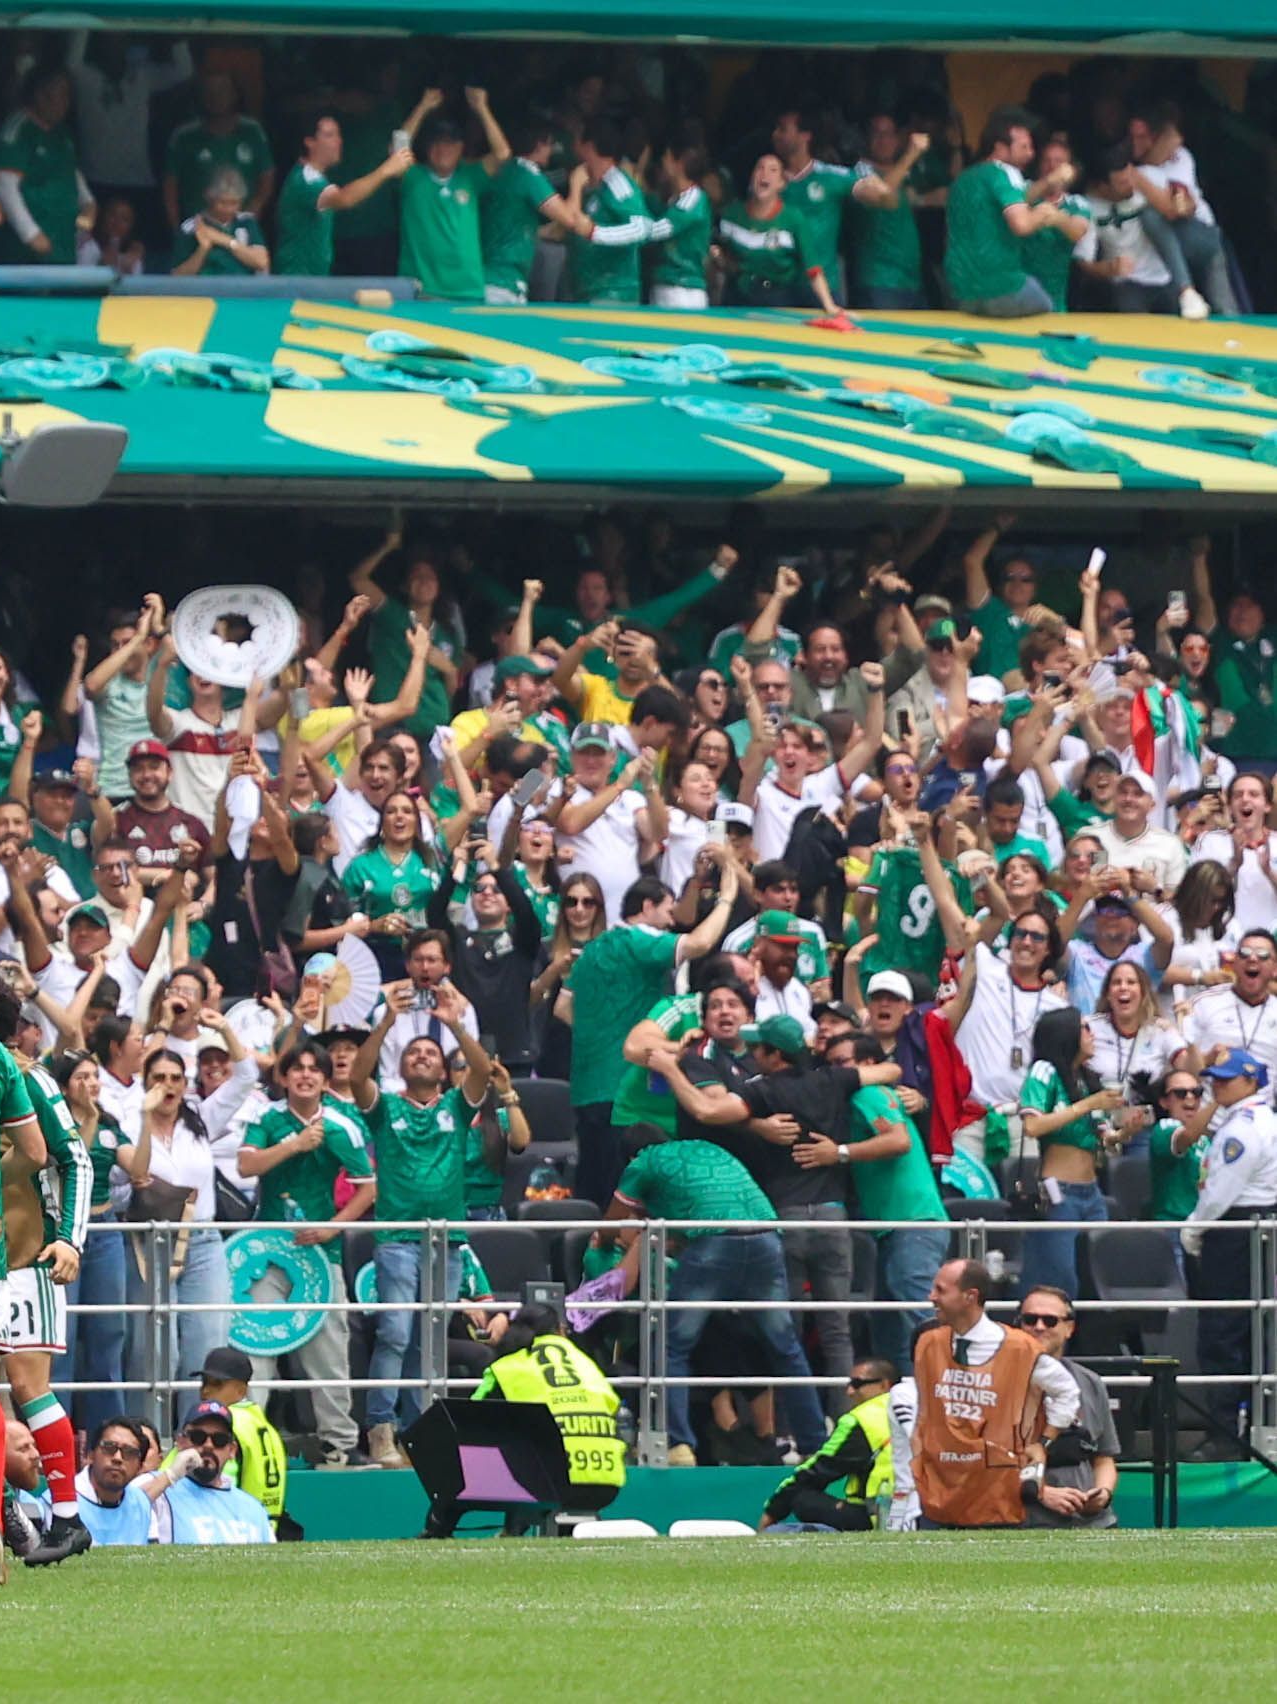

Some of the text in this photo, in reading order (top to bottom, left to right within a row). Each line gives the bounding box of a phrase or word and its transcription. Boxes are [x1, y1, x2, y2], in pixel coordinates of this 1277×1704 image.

[900, 884, 936, 938] 9
[10, 1300, 35, 1337] 21
[942, 1369, 993, 1388] MEDIA
[934, 1384, 998, 1406] PARTNER
[944, 1402, 984, 1421] 1522
[554, 1415, 616, 1435] CURITY
[566, 1450, 615, 1471] 995
[939, 1451, 982, 1463] FIFA.com
